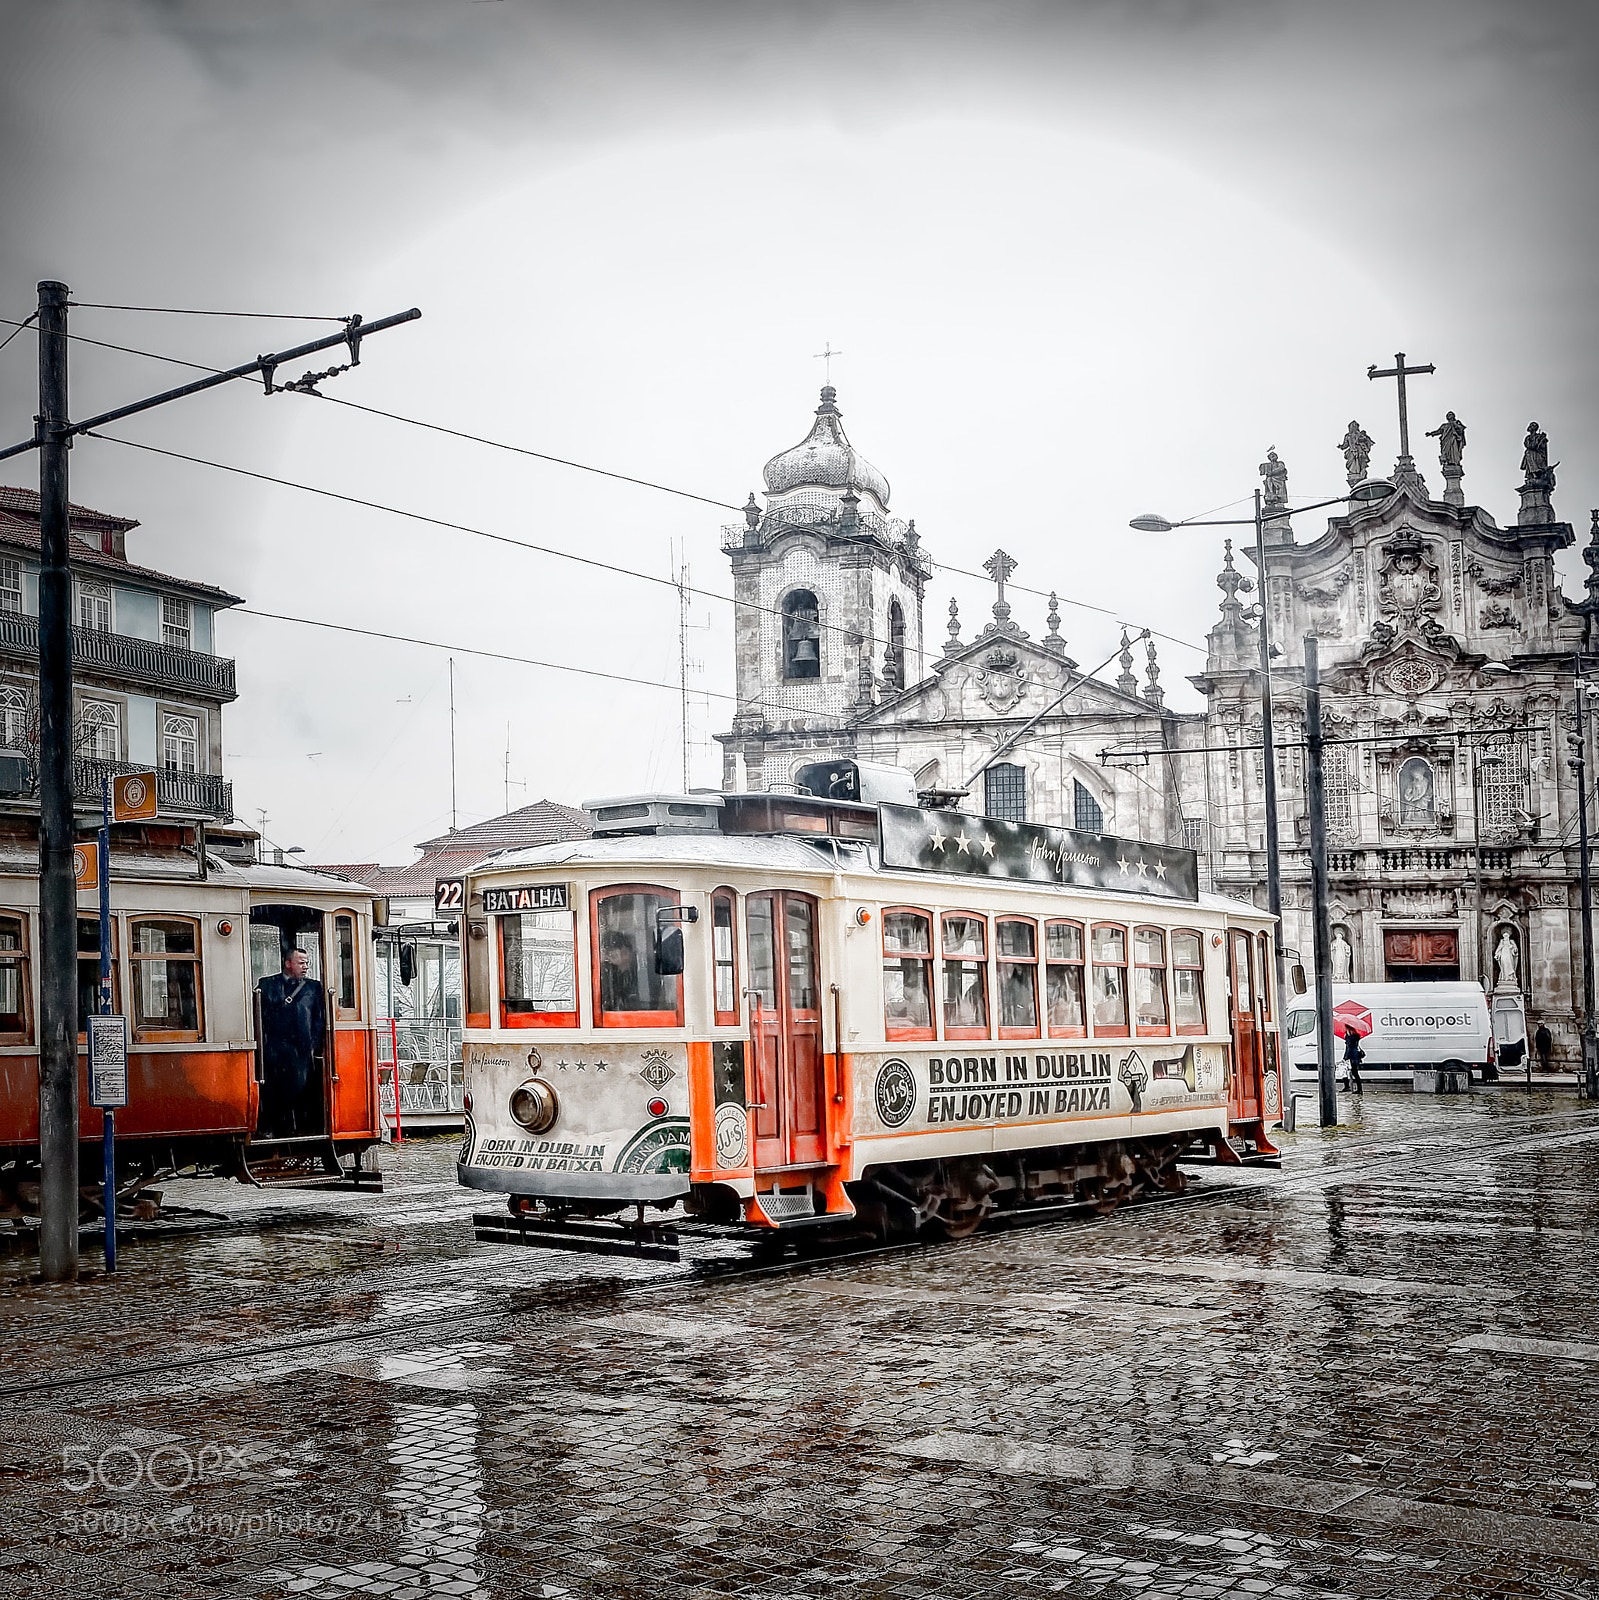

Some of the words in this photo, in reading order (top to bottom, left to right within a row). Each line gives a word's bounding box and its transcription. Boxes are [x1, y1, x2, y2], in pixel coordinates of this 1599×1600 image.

[1025, 836, 1056, 872] John
[1056, 841, 1100, 874] Jameson
[437, 882, 463, 909] 22
[486, 887, 565, 911] BATALHA
[1380, 1013, 1471, 1029] chronopost
[929, 1057, 997, 1085] BORN
[1005, 1056, 1027, 1081] IN
[1036, 1053, 1111, 1079] DUBLIN
[884, 1079, 907, 1107] JJ&S
[927, 1092, 1021, 1123] ENJOYED
[1028, 1090, 1050, 1116] IN
[1055, 1086, 1111, 1113] BAIXA
[480, 1139, 516, 1151] BORN
[518, 1140, 536, 1153] IN
[537, 1141, 606, 1157] DUBLIN
[717, 1124, 742, 1152] JJ&S
[474, 1154, 524, 1168] ENJOYED
[526, 1158, 544, 1169] IN
[545, 1158, 603, 1172] BAIXA
